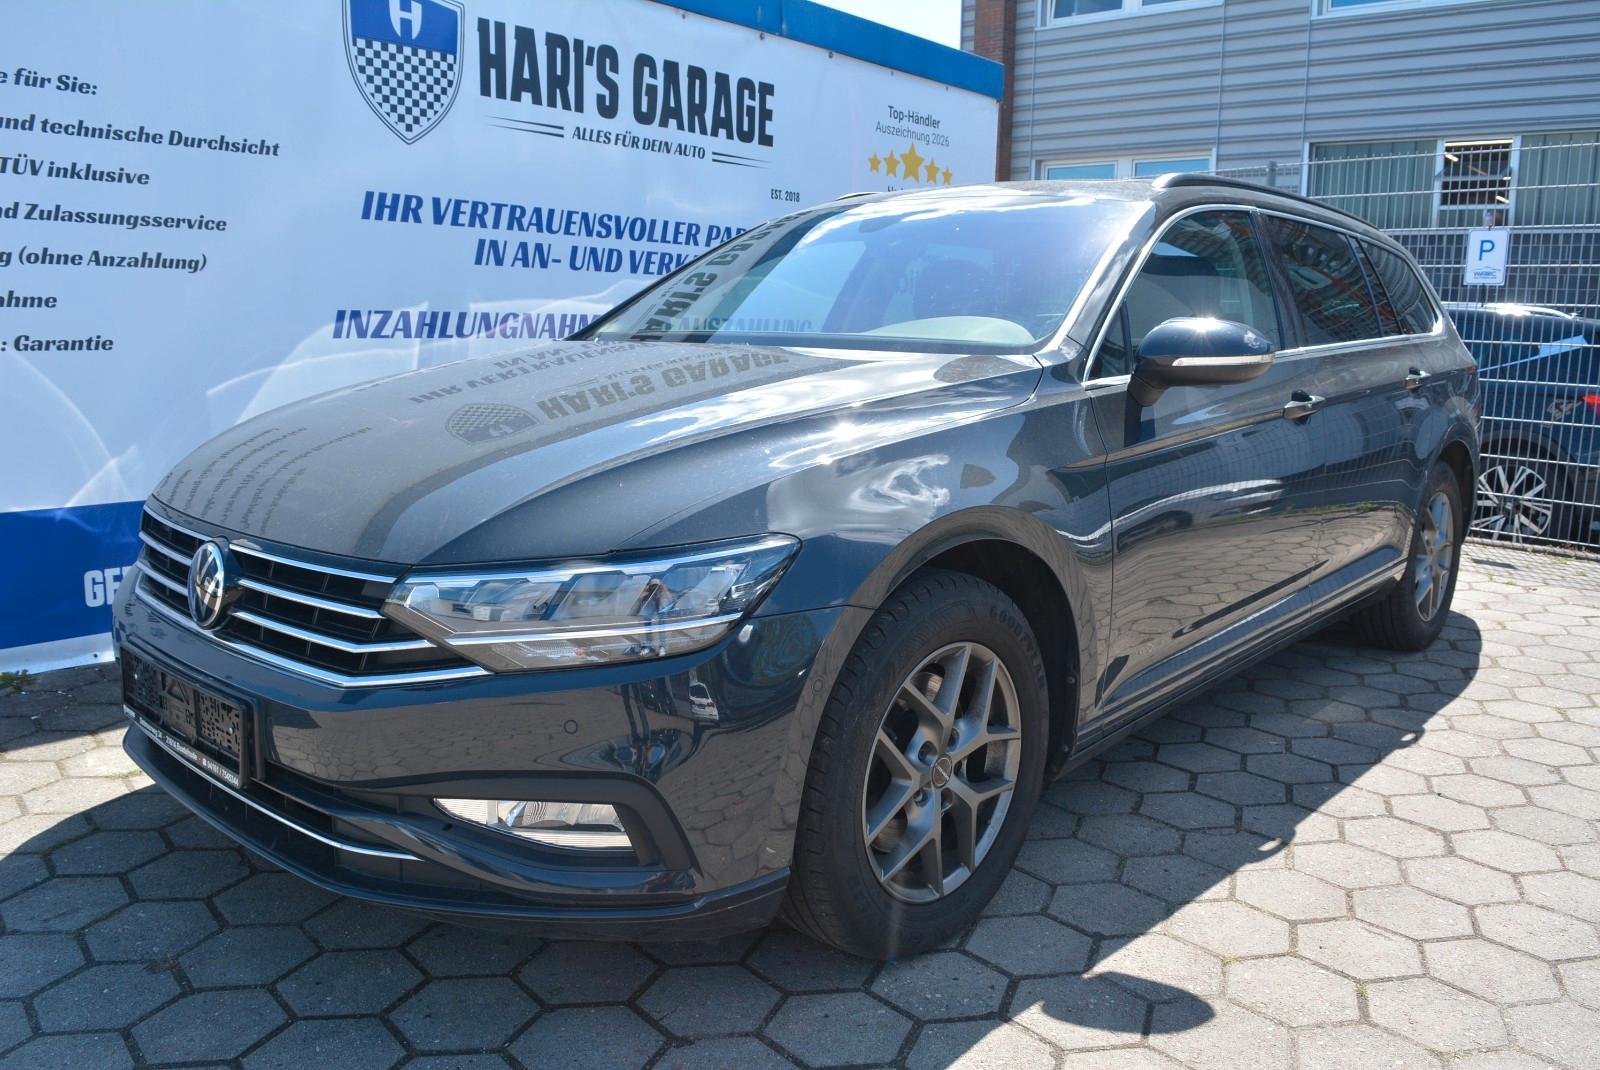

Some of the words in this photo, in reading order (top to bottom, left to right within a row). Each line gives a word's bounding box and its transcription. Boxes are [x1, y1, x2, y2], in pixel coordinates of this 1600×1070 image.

[14, 67, 52, 88] für
[56, 74, 98, 96] Sie:
[476, 17, 620, 120] HARI'S
[632, 53, 775, 148] GARAGE
[887, 104, 941, 129] Top-Händler
[40, 117, 164, 145] technische
[168, 130, 280, 157] Durchsicht
[572, 126, 612, 145] ALLES
[614, 130, 640, 150] FÜR
[641, 137, 673, 155] DEIN
[673, 143, 706, 160] AUTO
[875, 120, 931, 146] Auszeichnung
[931, 132, 950, 147] 2026
[0, 153, 44, 176] TÜV
[47, 160, 151, 186] inklusive
[770, 188, 784, 201] EST.
[784, 190, 801, 203] 2018
[24, 203, 228, 232] Zulassungsservice
[361, 190, 424, 224] IHR
[432, 196, 701, 248] VERTRAUENSVOLLER
[19, 245, 84, 266] (ohne
[87, 250, 208, 274] Anzahlung)
[474, 239, 506, 267] IN
[511, 240, 562, 269] AN-
[568, 246, 624, 274] UND
[1478, 239, 1495, 261] P
[14, 334, 114, 352] Garantie
